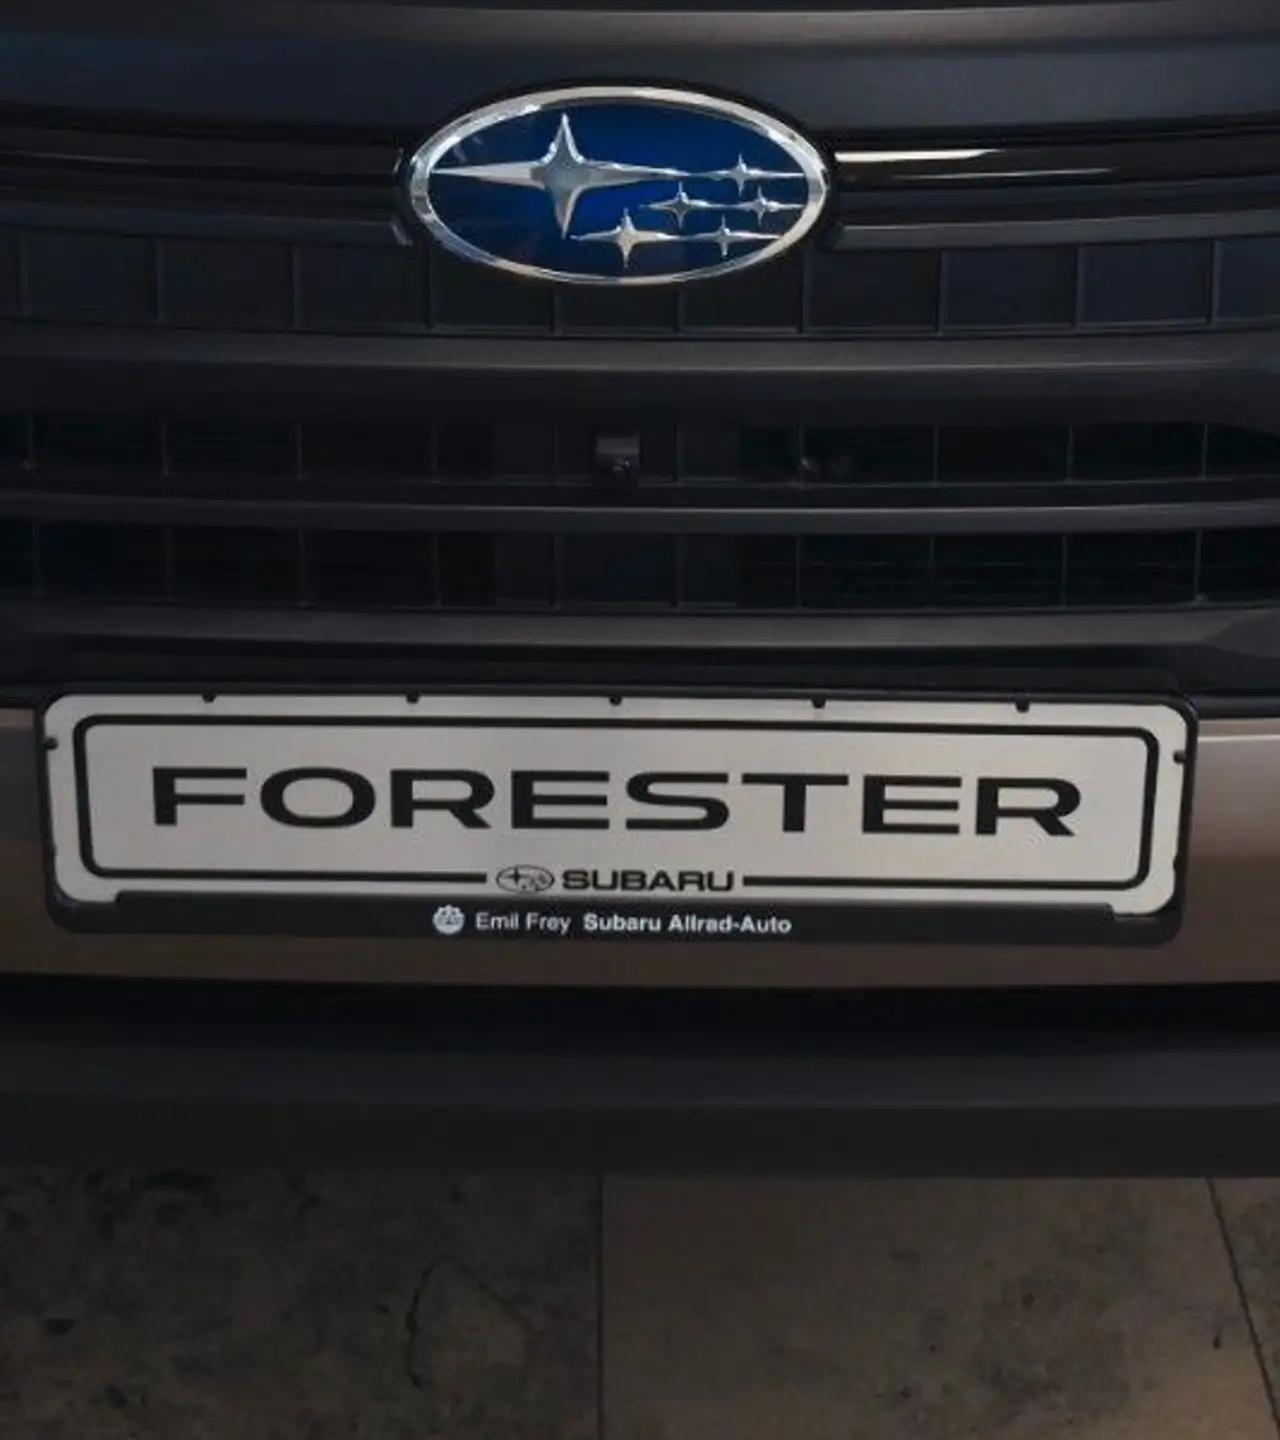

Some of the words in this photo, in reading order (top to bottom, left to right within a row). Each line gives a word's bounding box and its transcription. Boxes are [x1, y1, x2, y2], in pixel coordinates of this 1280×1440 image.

[152, 766, 1081, 837] FORESTER
[562, 869, 734, 892] SUBARU
[475, 911, 520, 931] Emil
[525, 912, 571, 936] Frey
[583, 912, 662, 932] Subaru
[668, 913, 793, 934] Allrad-Auto
